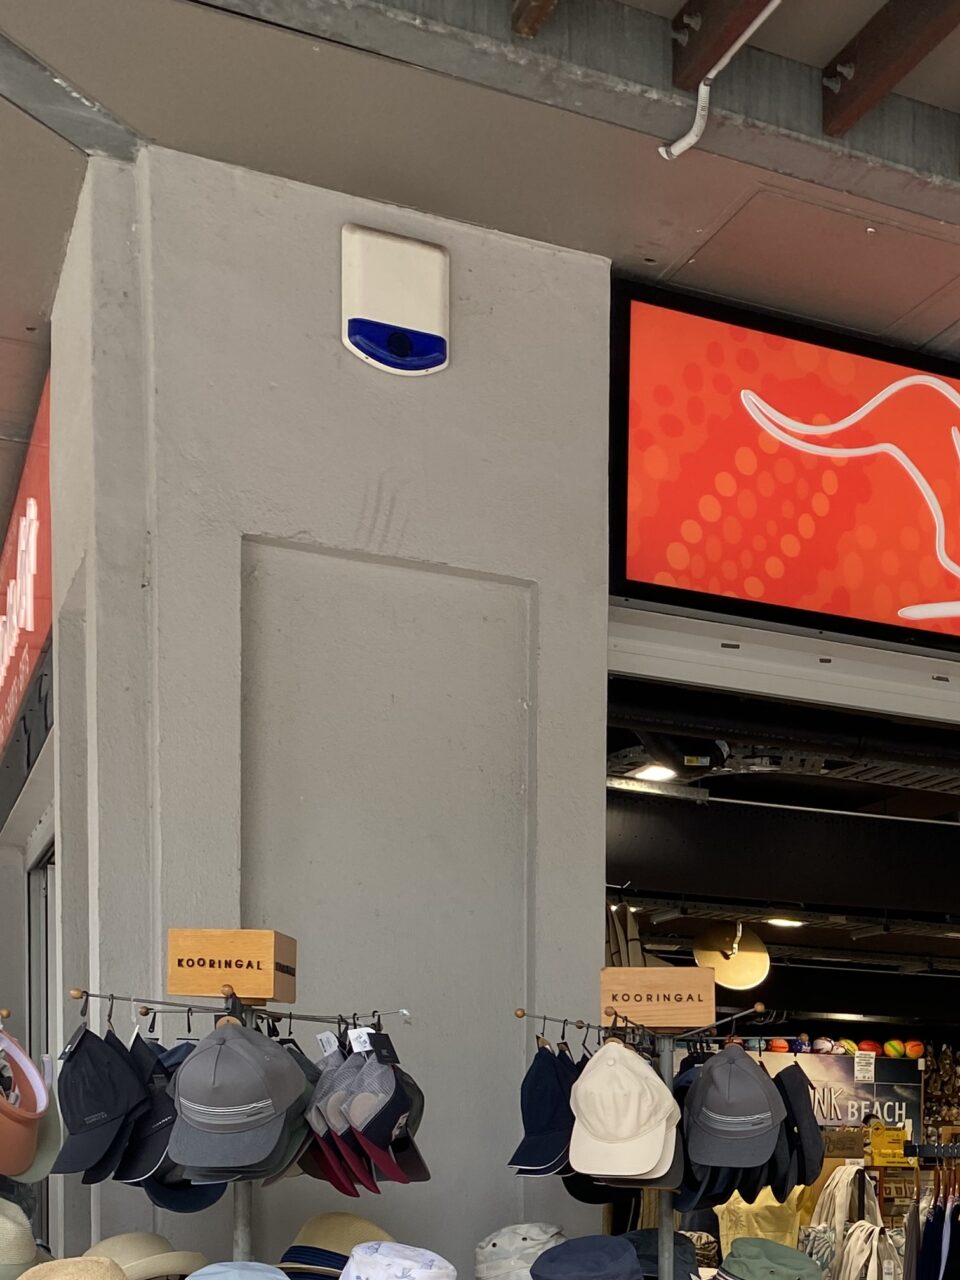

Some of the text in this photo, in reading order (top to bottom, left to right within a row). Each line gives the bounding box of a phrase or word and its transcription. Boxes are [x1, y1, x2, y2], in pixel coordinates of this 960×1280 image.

[177, 957, 263, 971] KOORINGAL
[612, 993, 704, 1003] KOORINGAL
[847, 1101, 907, 1122] BEACH
